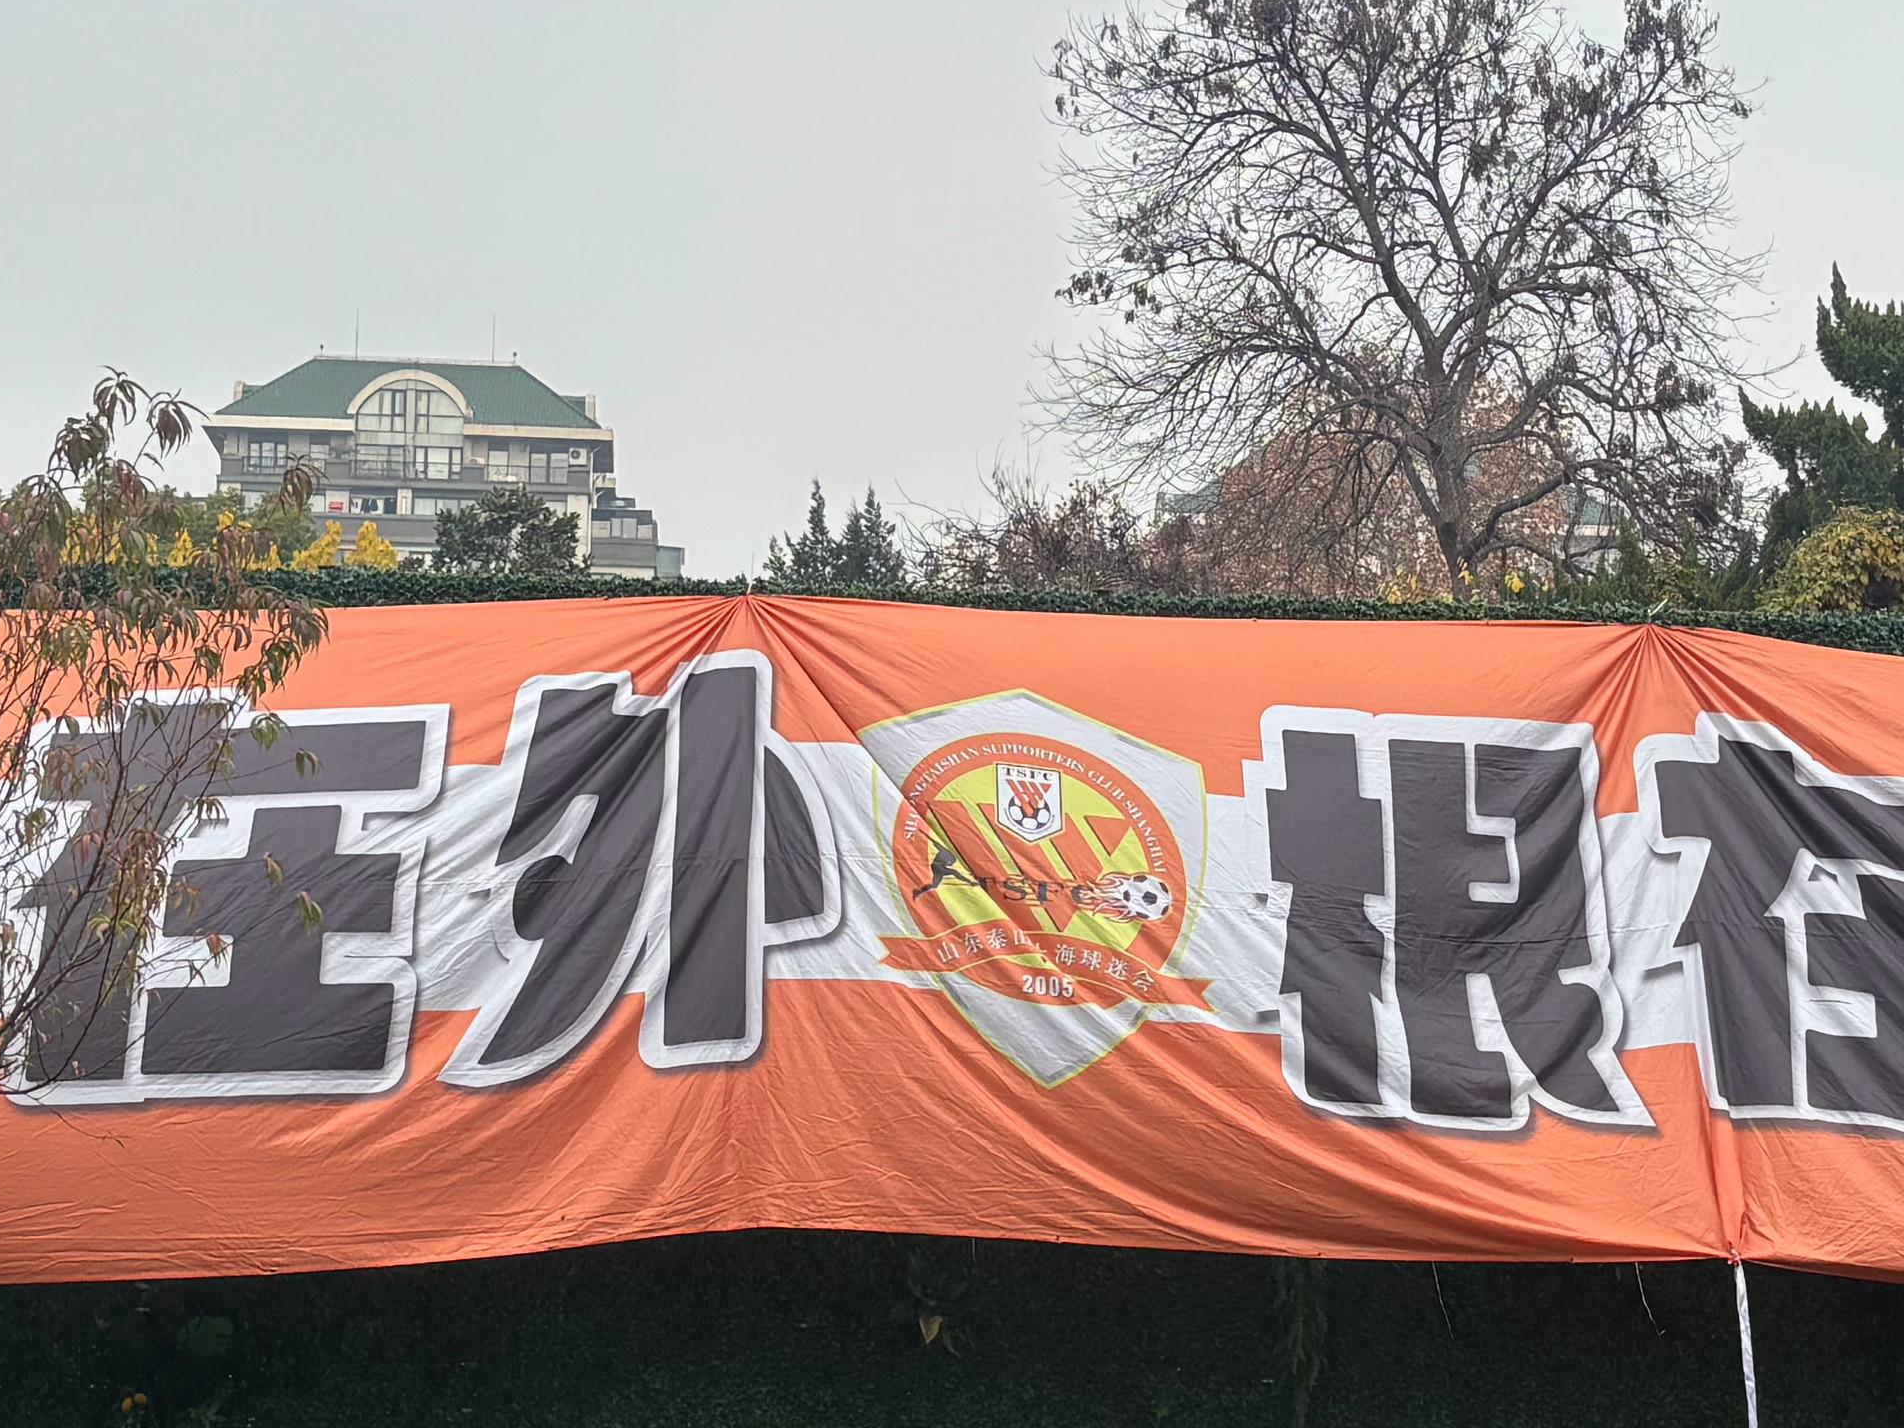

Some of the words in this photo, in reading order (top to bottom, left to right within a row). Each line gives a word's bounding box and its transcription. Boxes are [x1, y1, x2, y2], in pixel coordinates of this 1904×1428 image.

[1002, 766, 1053, 781] TSFC
[982, 743, 1086, 773] SUPPORTERS
[1088, 770, 1125, 800] CLUB
[1123, 800, 1168, 873] SHANGHAI
[1022, 974, 1075, 997] 2005
